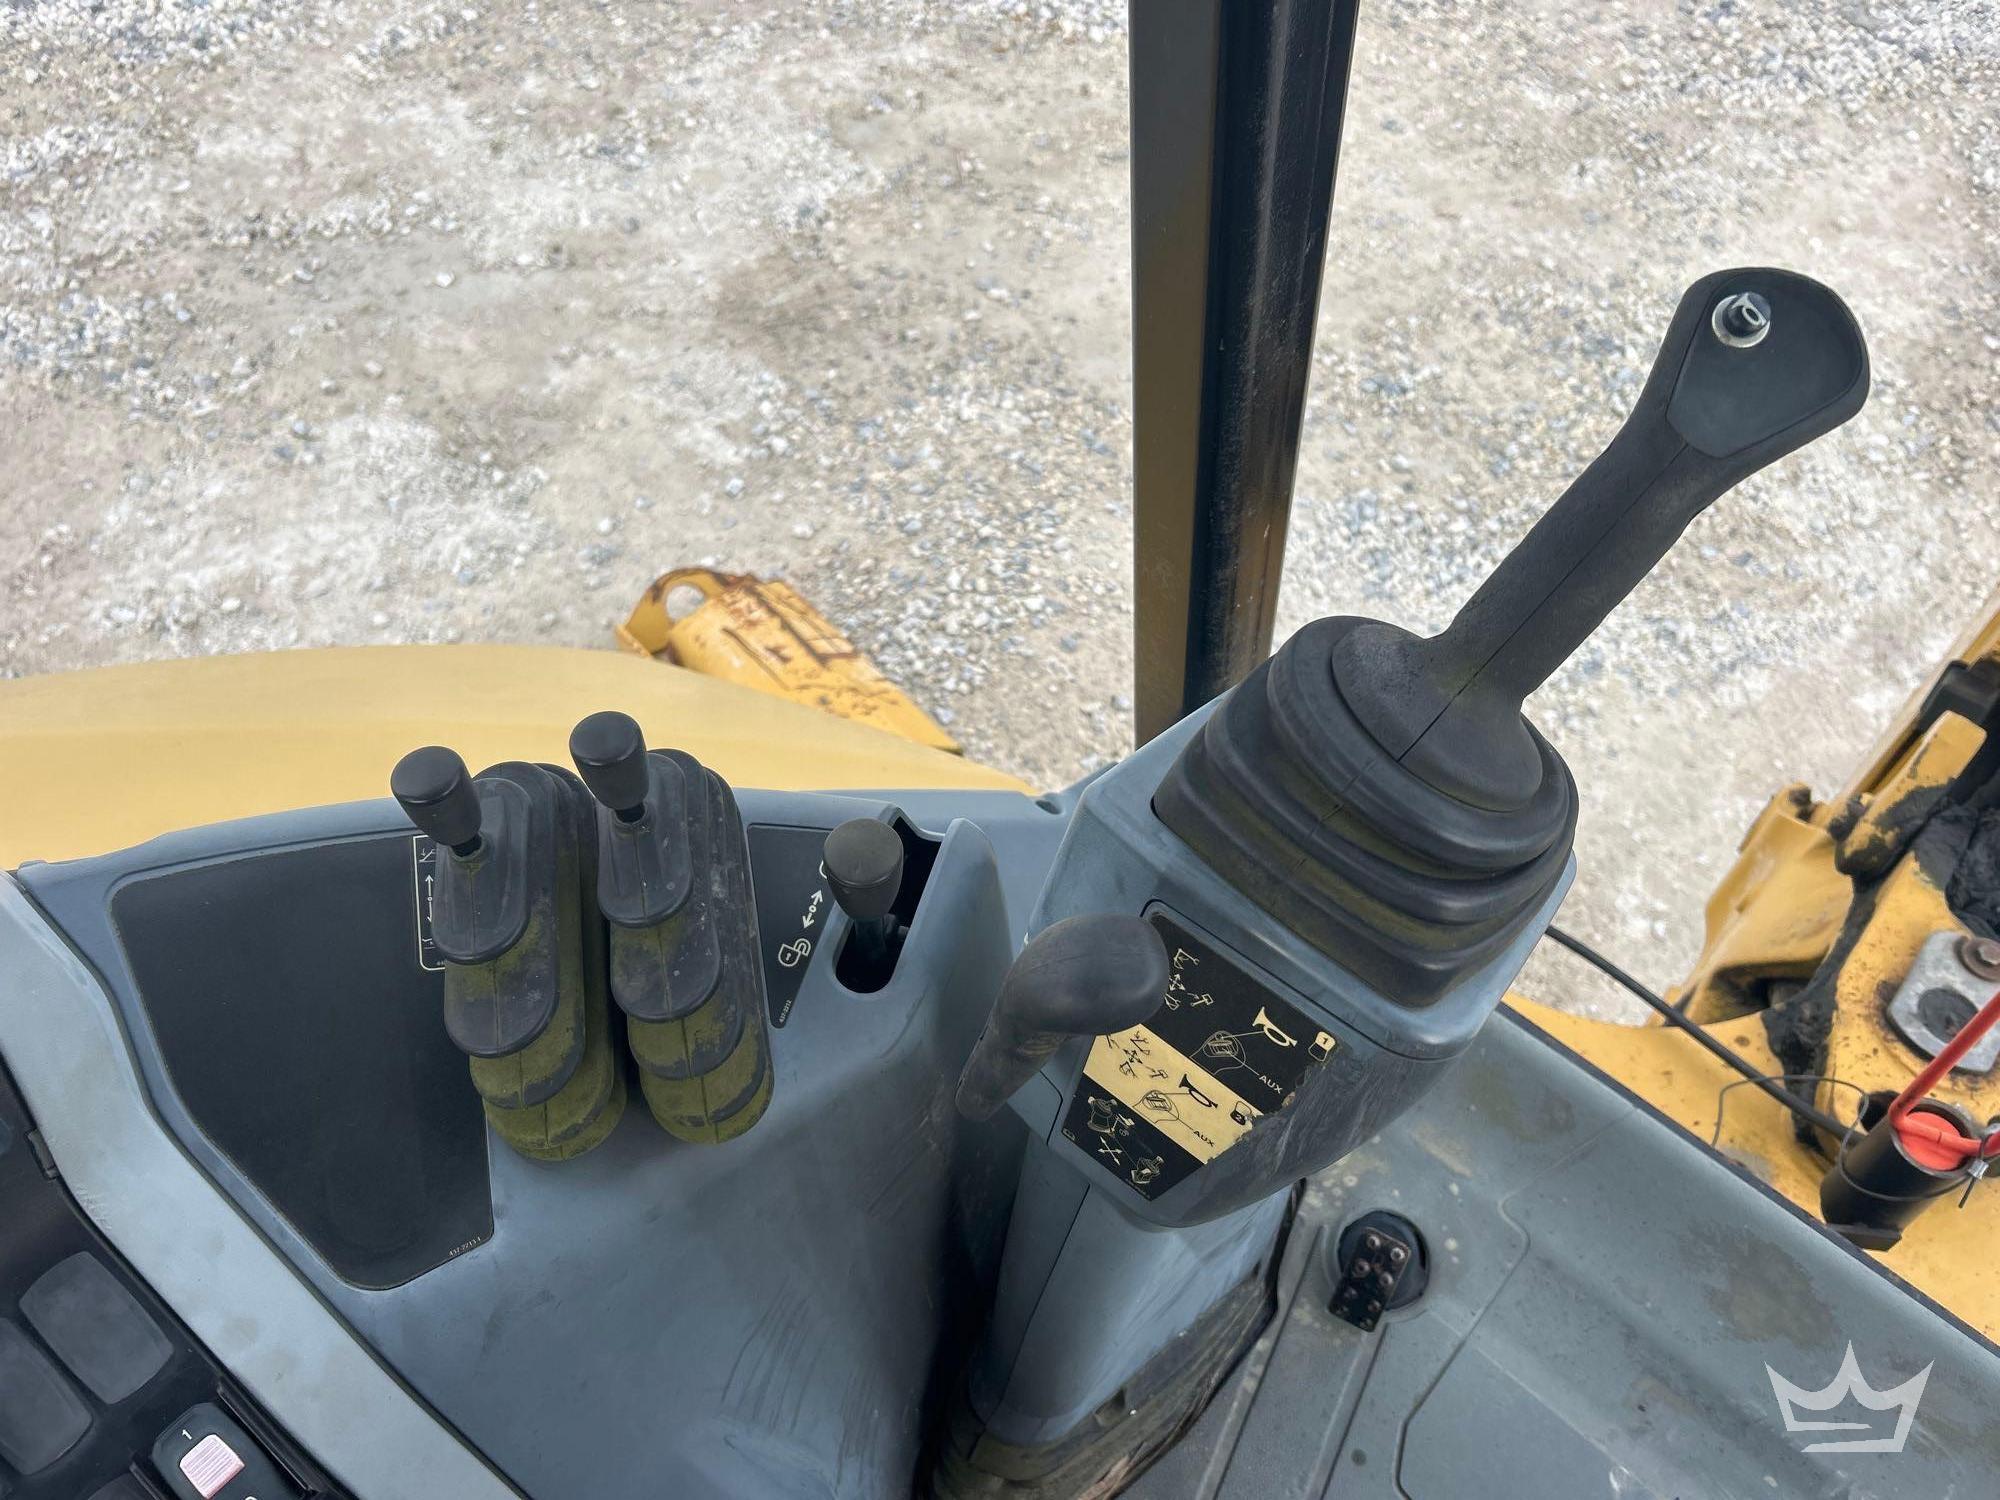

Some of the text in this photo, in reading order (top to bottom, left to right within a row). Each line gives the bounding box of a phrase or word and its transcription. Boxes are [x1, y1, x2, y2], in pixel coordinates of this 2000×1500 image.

[1258, 1075, 1283, 1094] AUX
[1193, 1130, 1215, 1147] AUX
[182, 1429, 192, 1440] 1
